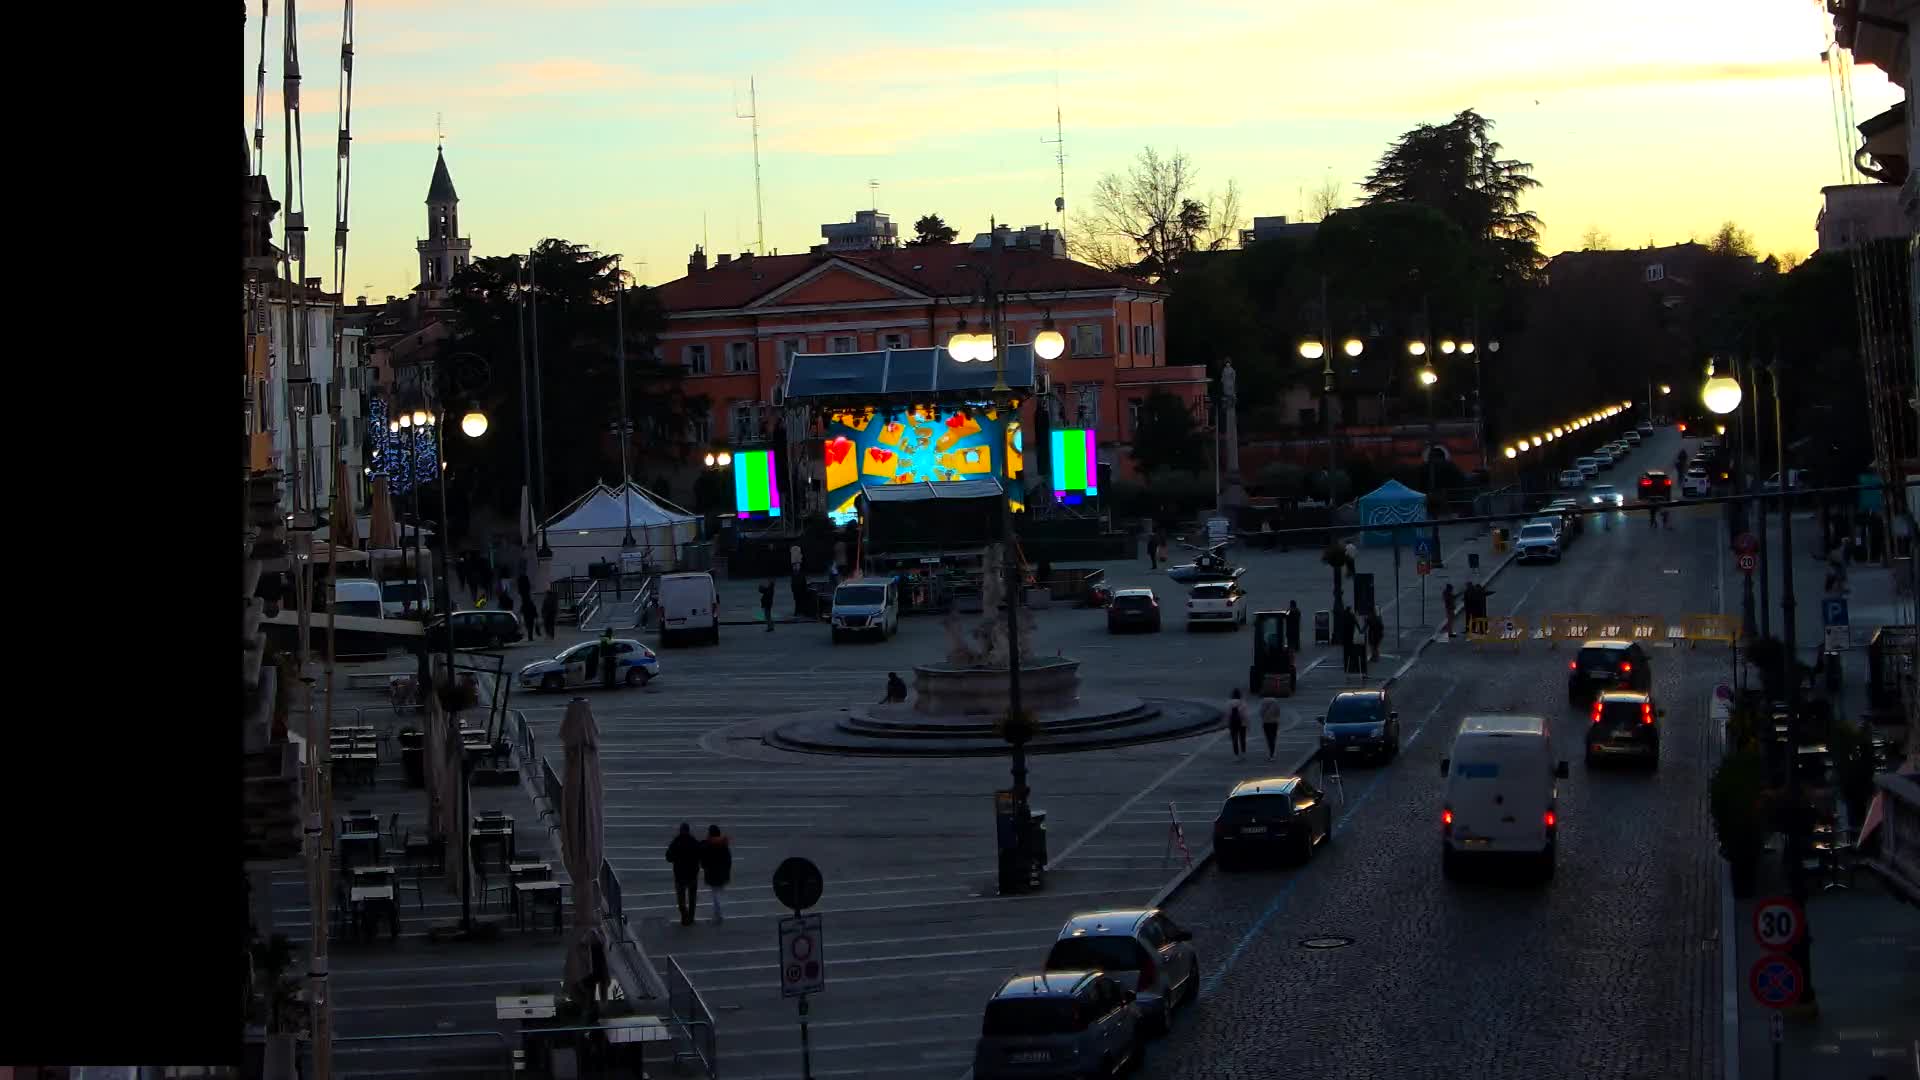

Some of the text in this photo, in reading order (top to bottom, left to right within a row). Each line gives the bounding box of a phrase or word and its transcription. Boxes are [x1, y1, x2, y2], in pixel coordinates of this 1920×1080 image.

[1743, 557, 1752, 567] 20
[1828, 602, 1841, 625] P
[1763, 911, 1791, 937] 30
